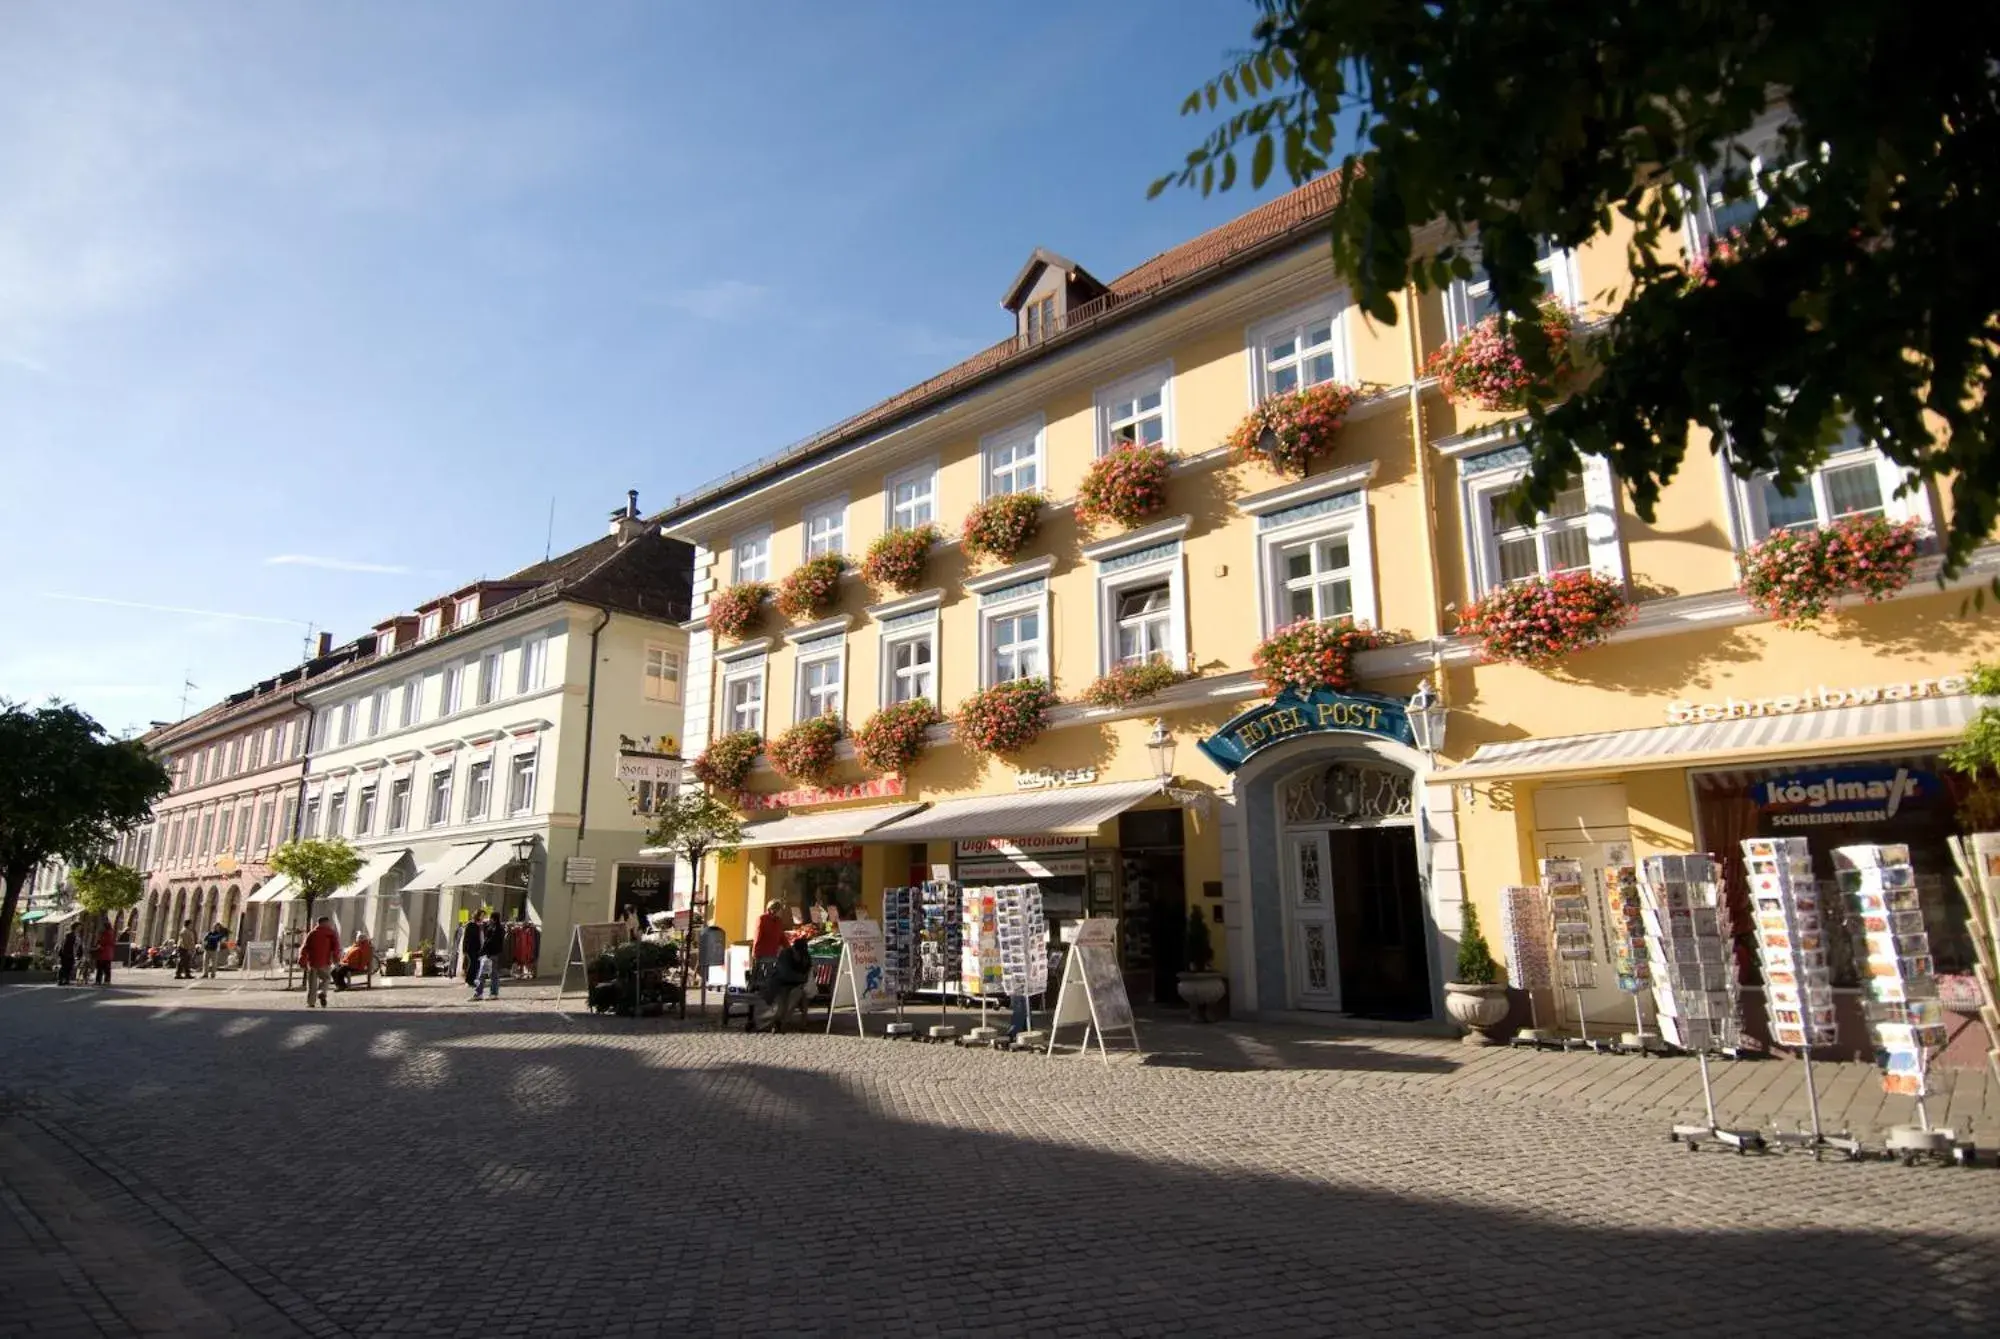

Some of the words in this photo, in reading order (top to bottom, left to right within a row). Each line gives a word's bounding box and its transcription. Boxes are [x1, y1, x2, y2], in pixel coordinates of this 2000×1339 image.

[1667, 675, 1979, 724] Schreibware
[1235, 706, 1309, 748] HOTEL
[1316, 702, 1382, 729] POST
[621, 765, 648, 777] Hotel
[1771, 809, 1886, 827] SCHREIBWAREN
